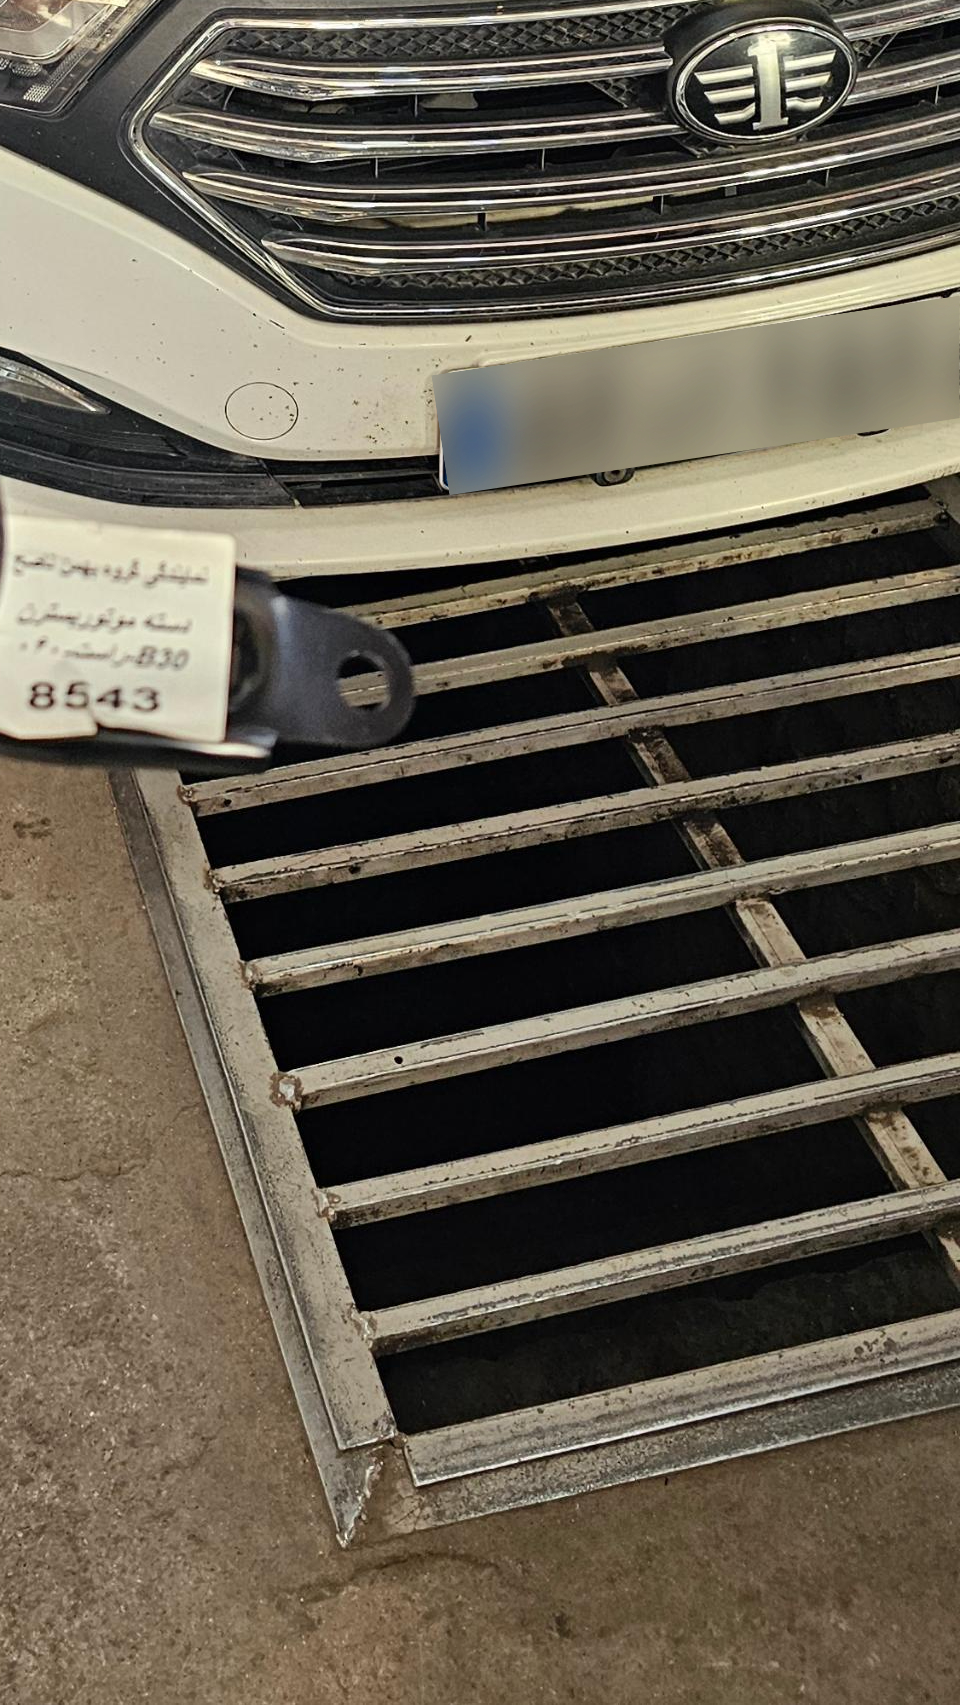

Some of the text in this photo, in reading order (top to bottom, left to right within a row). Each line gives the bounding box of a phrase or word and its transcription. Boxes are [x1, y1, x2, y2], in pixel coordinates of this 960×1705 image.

[60, 557, 97, 578] بهمن
[103, 557, 139, 582] گروه
[79, 608, 136, 632] موتور
[143, 612, 192, 633] دسته
[28, 682, 160, 713] 8543
